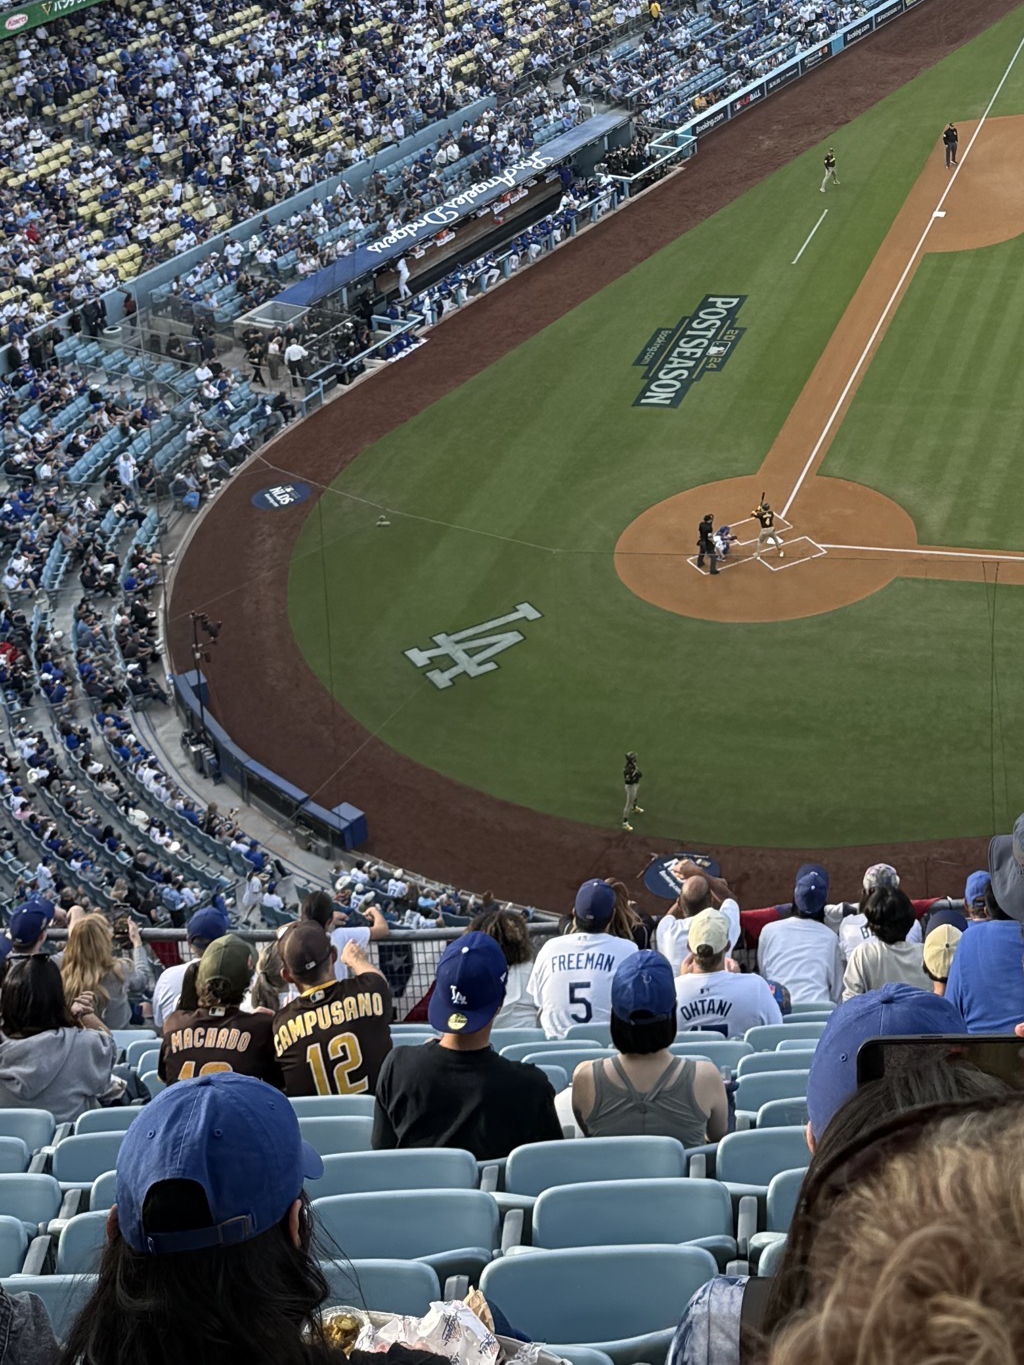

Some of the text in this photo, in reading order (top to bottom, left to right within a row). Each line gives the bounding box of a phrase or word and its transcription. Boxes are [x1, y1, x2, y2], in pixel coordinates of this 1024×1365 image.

[696, 112, 724, 134] Booking.com
[366, 205, 459, 255] Dodgers
[640, 330, 672, 365] Booking.com
[640, 297, 740, 405] POSTSEASON
[551, 952, 616, 973] FREEMAN
[568, 981, 593, 1024] 5
[680, 998, 733, 1021] OHTANI
[170, 1026, 251, 1054] MACHADO
[273, 992, 384, 1058] CAMPUSANO
[306, 1031, 369, 1096] 12
